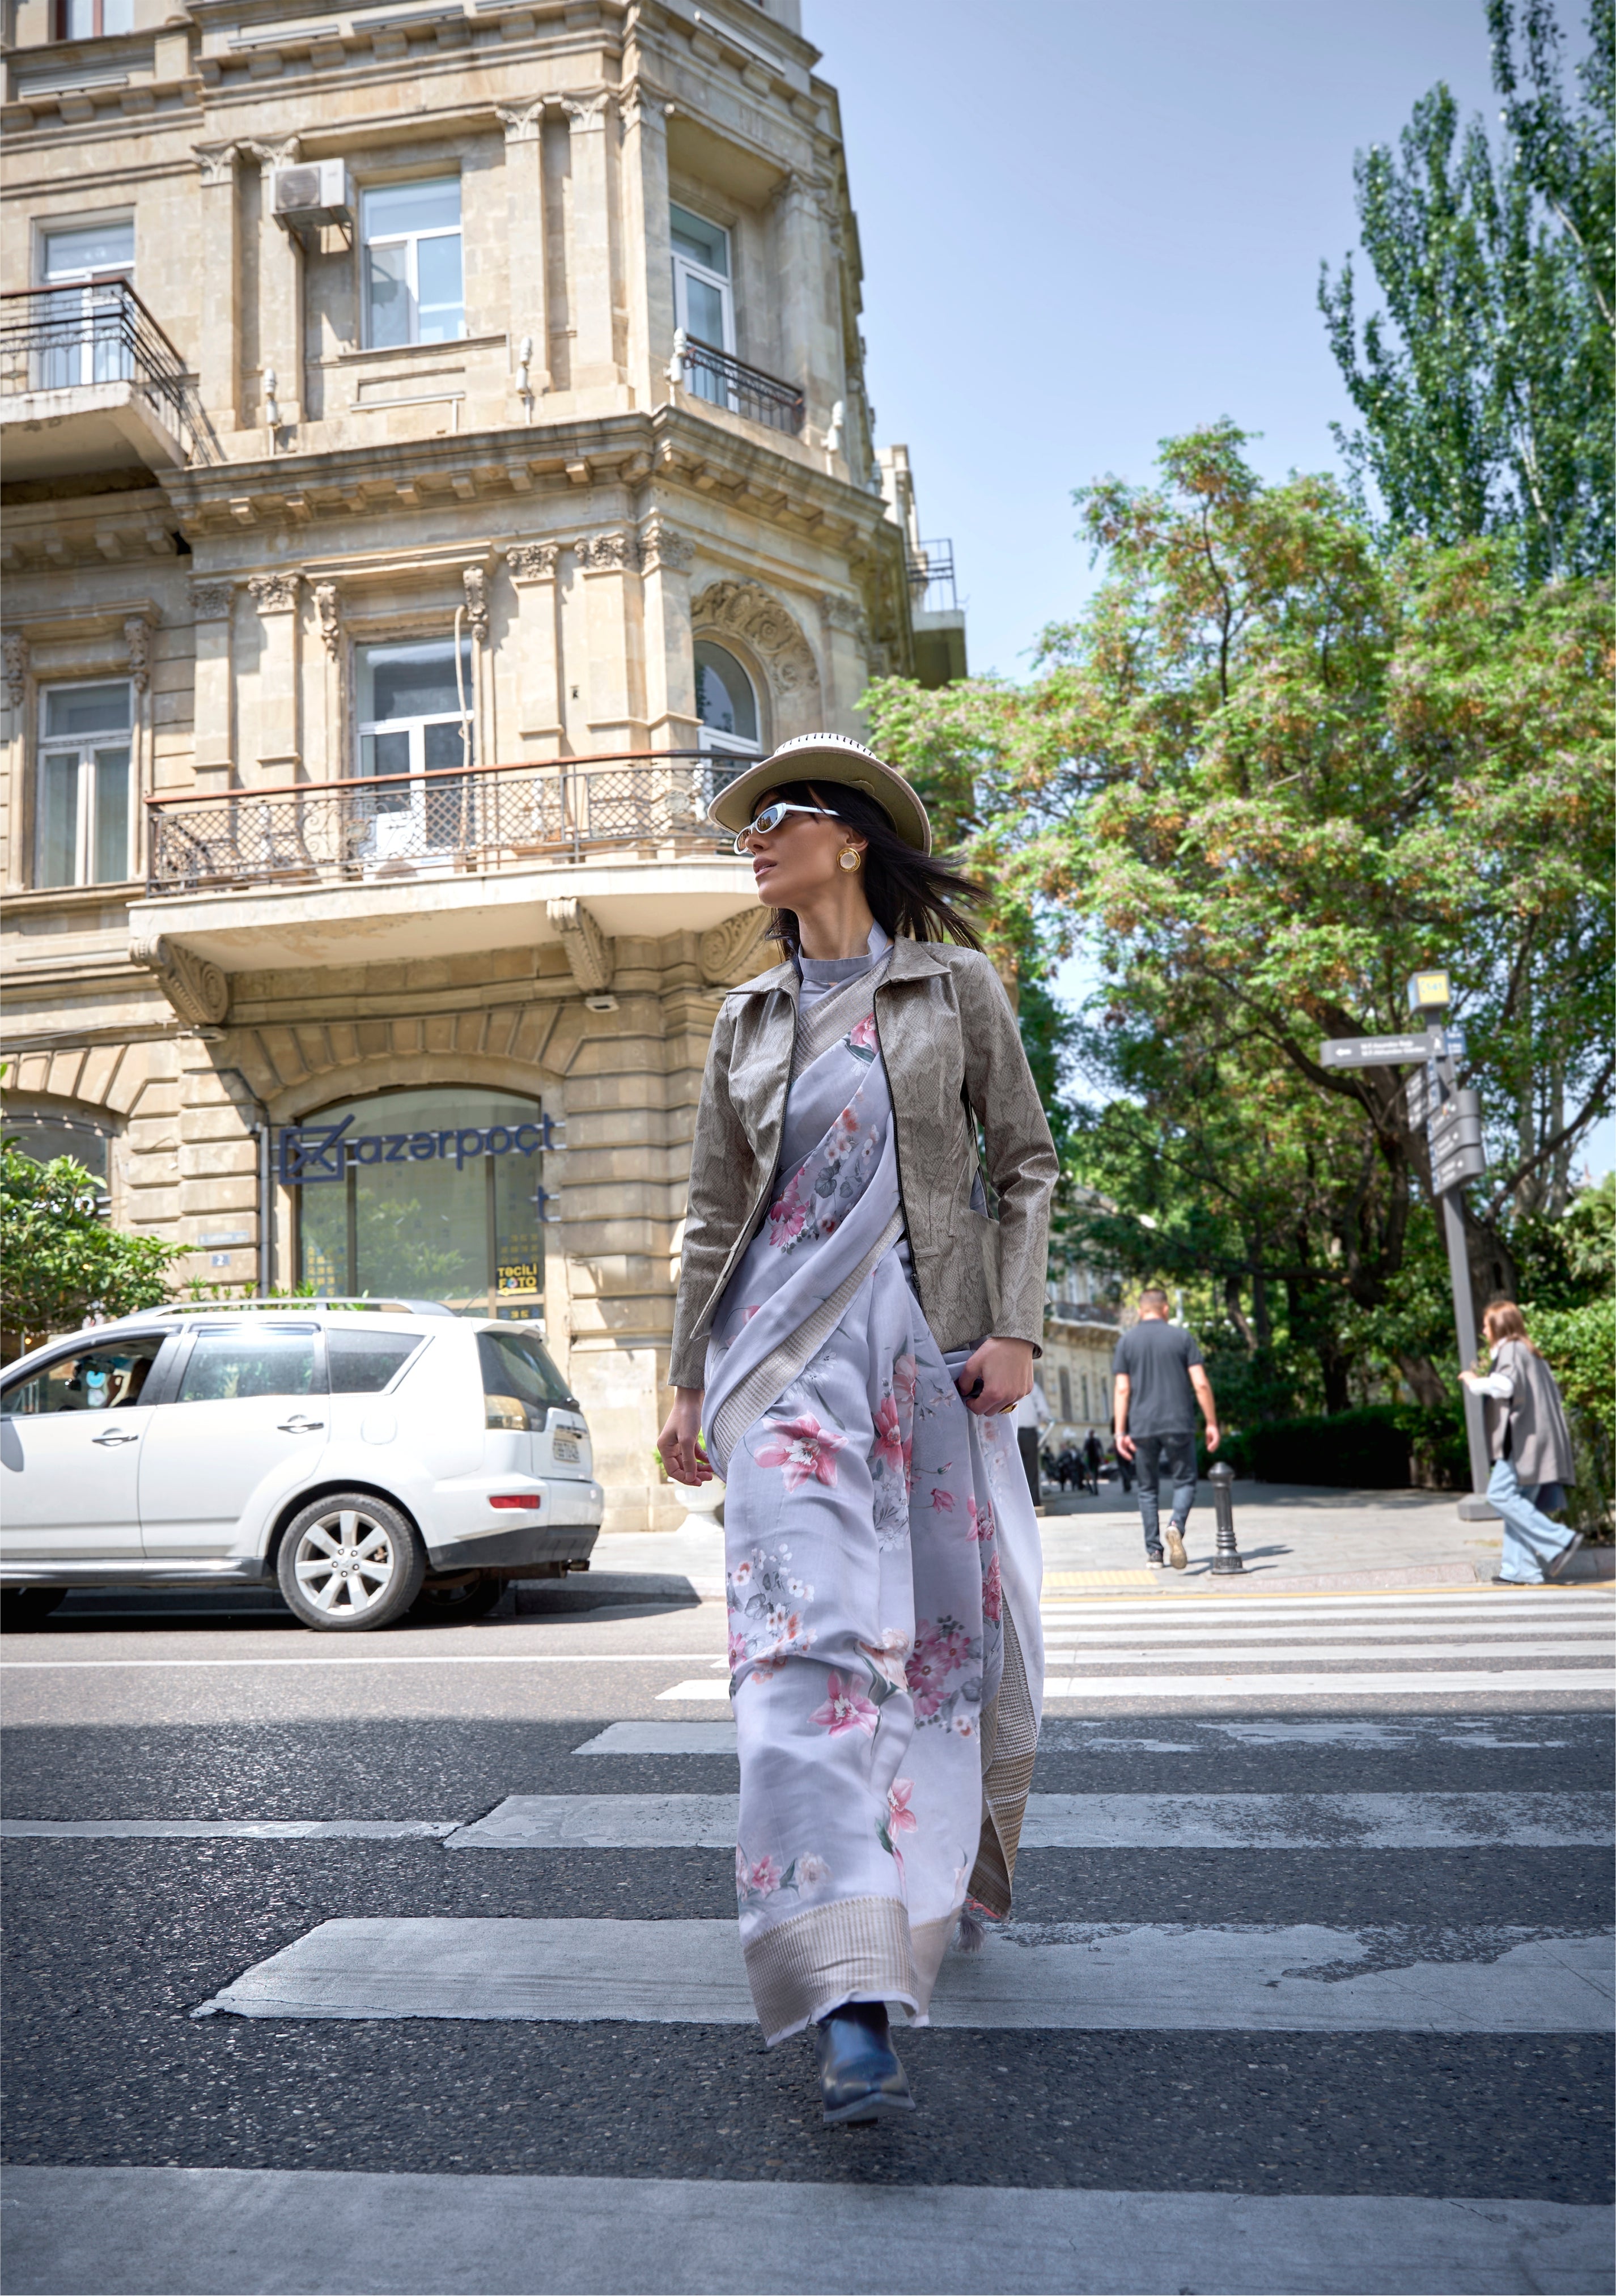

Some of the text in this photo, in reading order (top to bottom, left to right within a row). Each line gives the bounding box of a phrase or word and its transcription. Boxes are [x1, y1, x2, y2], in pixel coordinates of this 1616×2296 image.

[354, 1113, 555, 1172] azərpoçt
[217, 1254, 224, 1266] 2
[498, 1276, 537, 1289] FOTO
